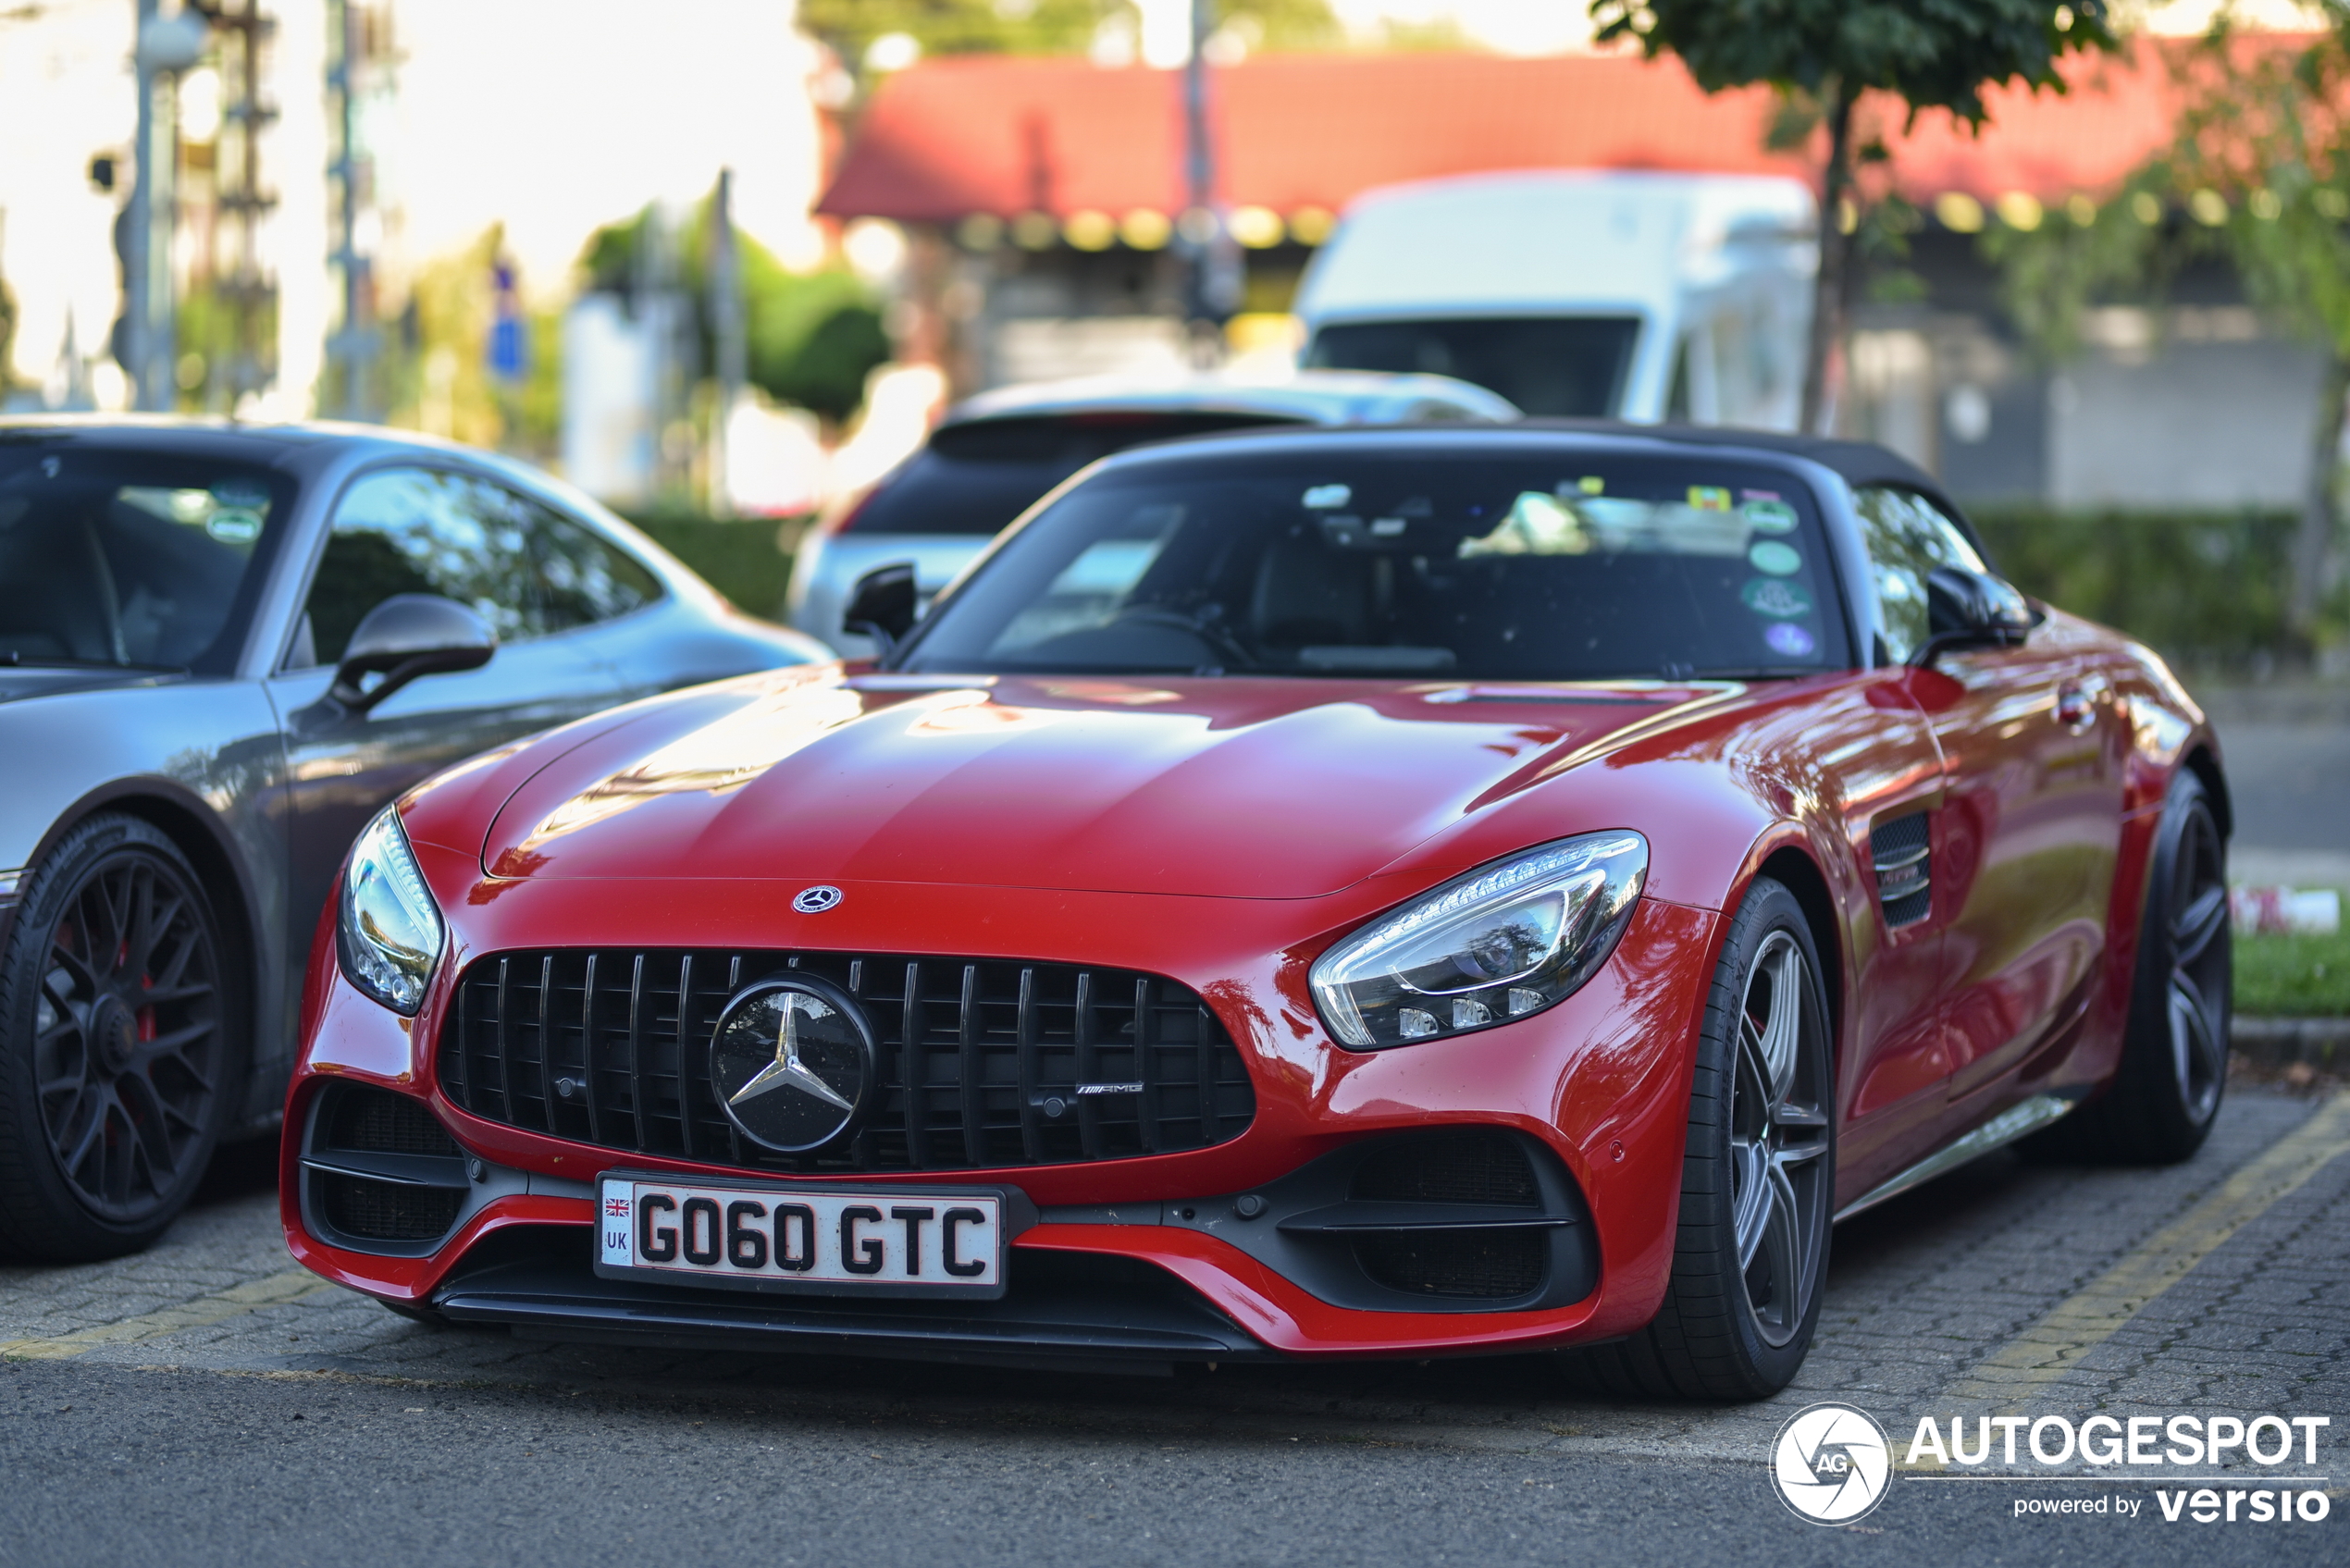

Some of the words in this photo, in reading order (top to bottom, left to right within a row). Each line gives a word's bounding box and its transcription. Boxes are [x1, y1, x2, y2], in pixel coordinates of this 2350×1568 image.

[1735, 958, 1748, 988] XL
[1727, 993, 1740, 1019] 19
[1724, 1025, 1735, 1062] ZR
[607, 1230, 627, 1251] UK
[840, 1204, 986, 1277] GTC
